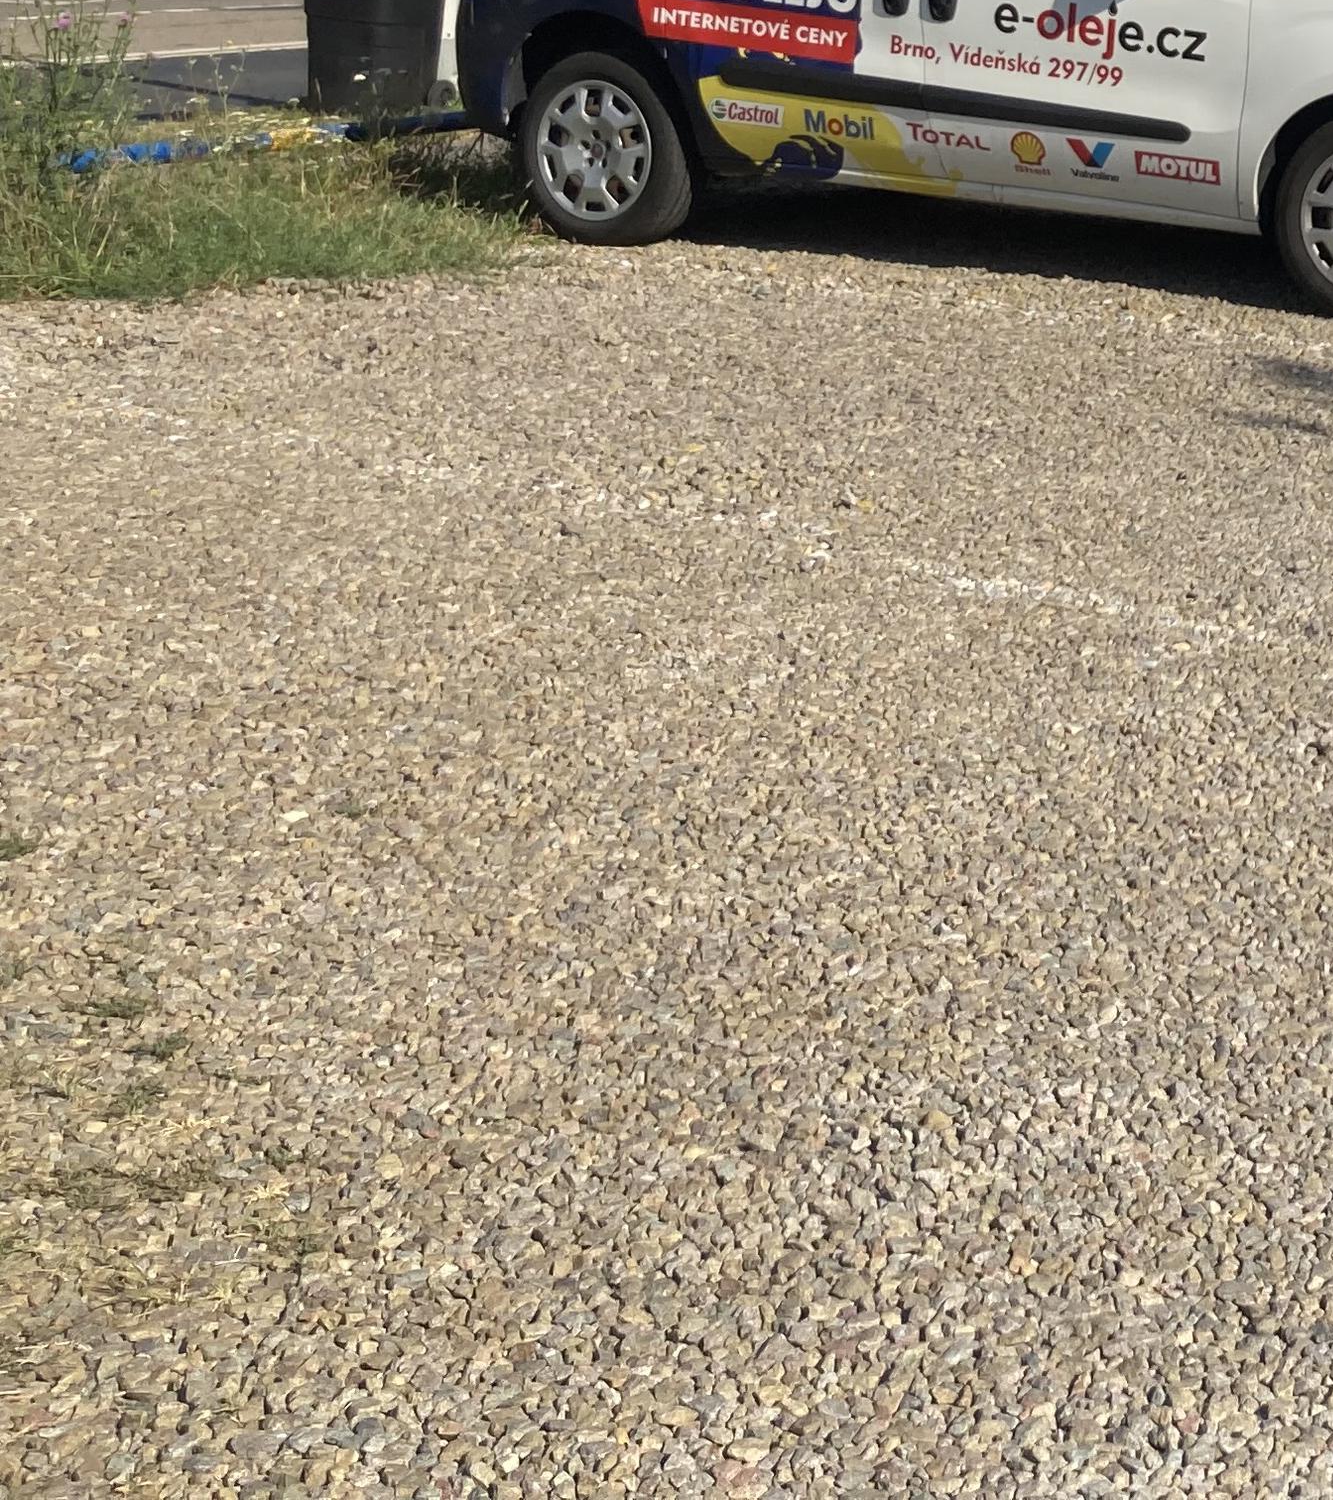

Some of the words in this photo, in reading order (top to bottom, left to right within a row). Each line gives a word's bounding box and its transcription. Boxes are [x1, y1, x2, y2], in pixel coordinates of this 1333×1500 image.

[652, 6, 790, 41] INTERNETOVÉ
[795, 25, 849, 48] CENY
[993, 0, 1208, 62] e-oleje.cz
[890, 34, 941, 65] Brno,
[949, 41, 1041, 76] Vídeňská
[1047, 56, 1124, 88] 297/99
[727, 102, 780, 125] Castrol
[804, 108, 876, 141] Mobil
[905, 121, 992, 152] TOTAL
[1014, 165, 1051, 177] Shell
[1069, 167, 1120, 183] Valvoline
[1139, 154, 1218, 183] MOTUL
